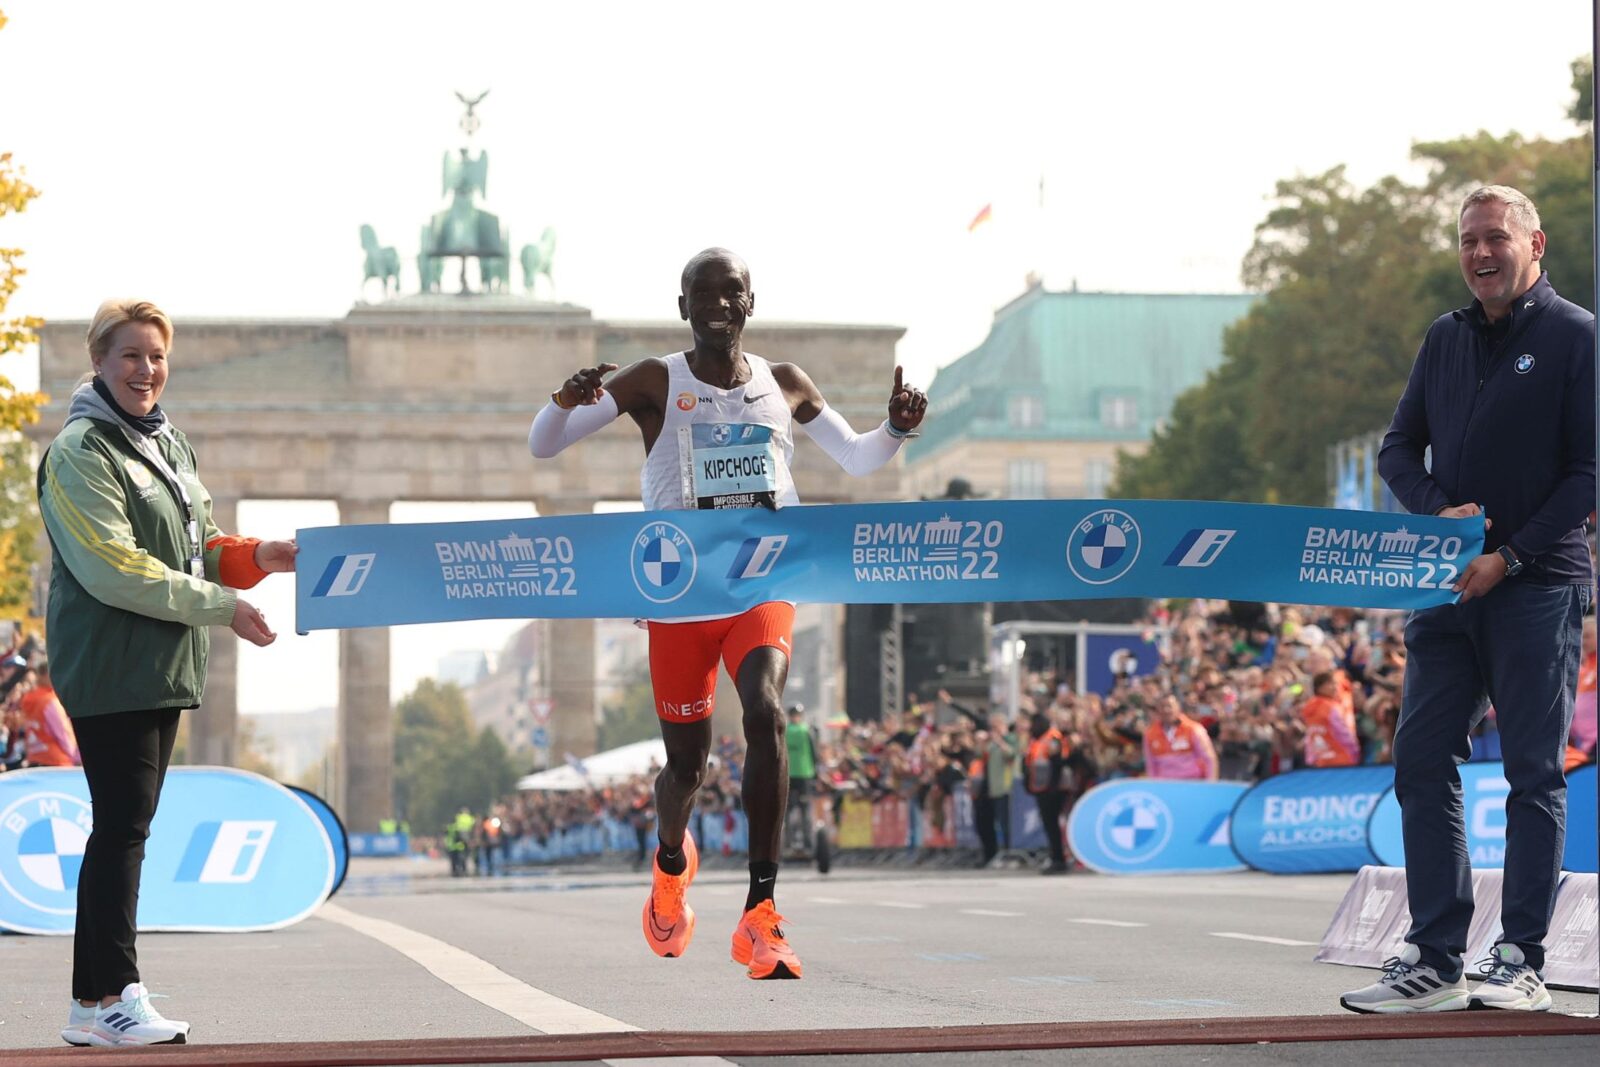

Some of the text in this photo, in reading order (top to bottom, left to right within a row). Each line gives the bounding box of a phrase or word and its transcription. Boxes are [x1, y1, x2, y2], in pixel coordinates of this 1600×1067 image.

[704, 455, 768, 480] KIPCHOGE
[713, 494, 755, 506] IMPOSSIBLE
[854, 522, 922, 546] BMW
[962, 520, 1003, 548] 20
[1080, 513, 1133, 534] BMW
[638, 525, 685, 548] BMW
[1305, 527, 1378, 550] BMW
[1418, 535, 1462, 561] 20
[435, 540, 497, 564] BMW
[535, 536, 574, 564] 20
[853, 547, 919, 564] BERLIN
[1302, 549, 1373, 567] BERLIN
[441, 563, 505, 581] BERLIN
[854, 564, 959, 582] MARATHON
[961, 551, 999, 580] 22
[1299, 566, 1414, 588] MARATHON
[1417, 562, 1458, 589] 22
[445, 580, 542, 600] MARATHON
[542, 567, 577, 596] 22
[662, 694, 713, 716] INEOS
